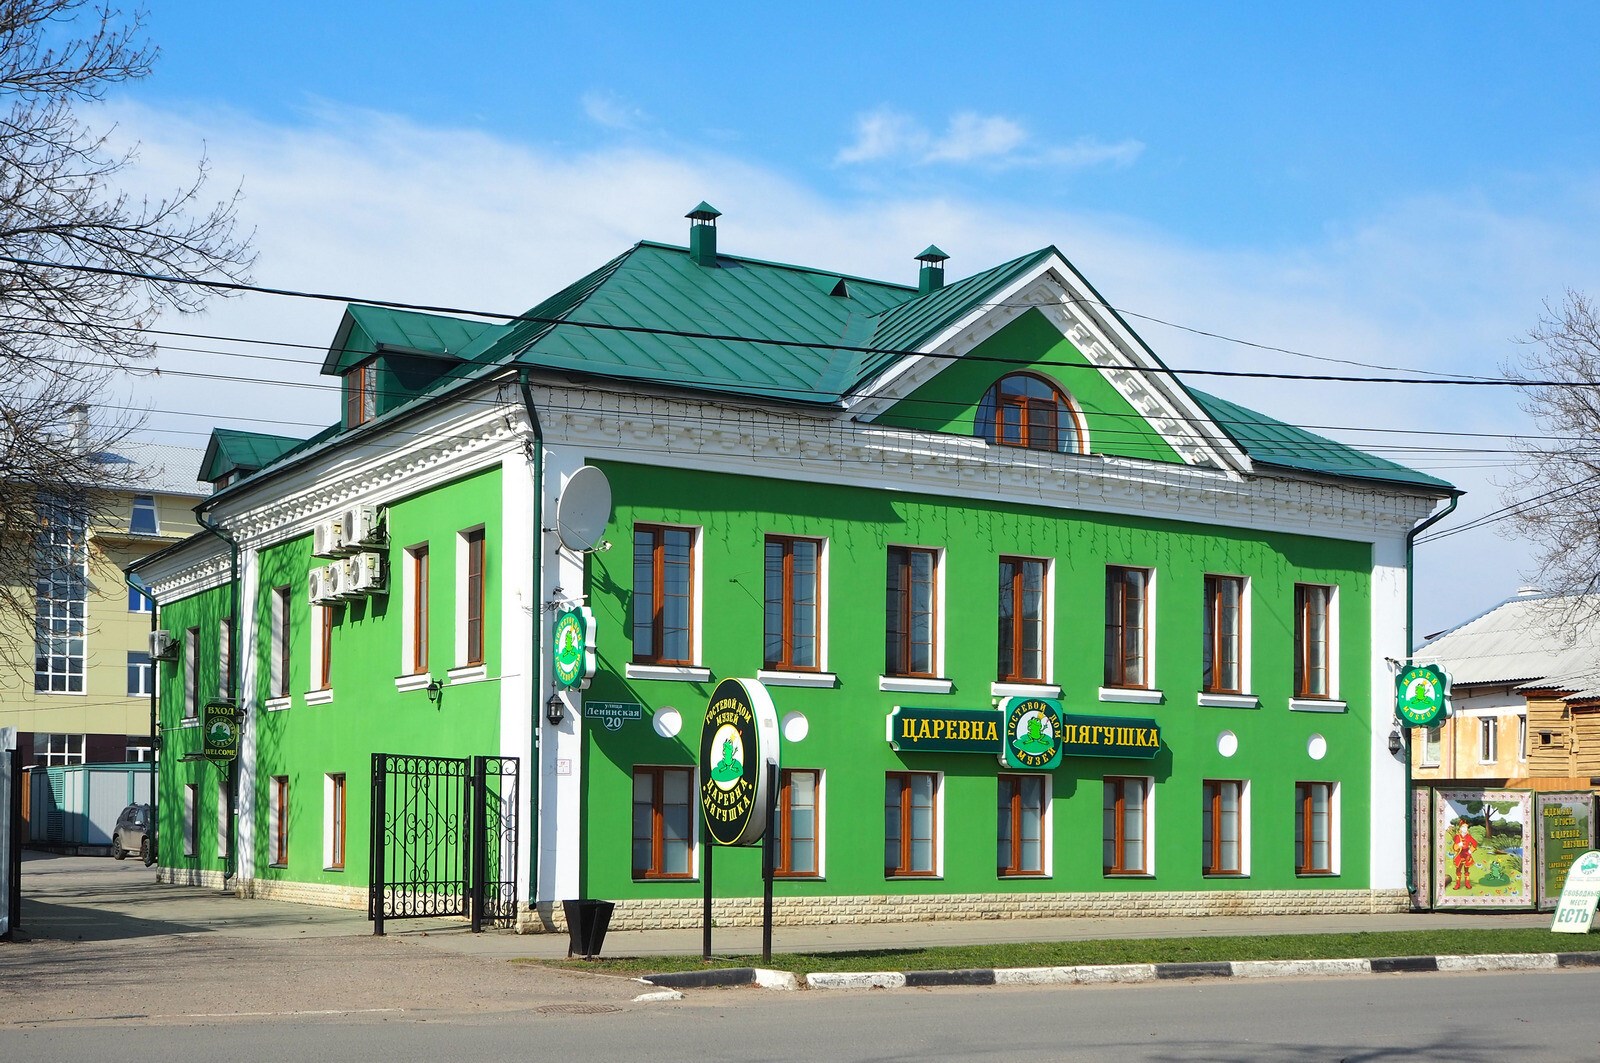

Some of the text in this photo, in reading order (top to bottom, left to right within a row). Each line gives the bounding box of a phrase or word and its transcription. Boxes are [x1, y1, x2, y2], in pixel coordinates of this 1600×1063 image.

[208, 706, 234, 716] ВХОД
[586, 707, 640, 716] Ленинская
[705, 698, 752, 726] ГОСТЕВОЙ ДОМ
[1403, 706, 1436, 720] MUSEUM
[606, 716, 622, 728] 20
[716, 712, 739, 726] МУЗЕЙ
[1049, 714, 1061, 738] ДОМ
[902, 718, 1160, 748] ЦАРЕВНА ЛЯГУШКА
[706, 778, 748, 806] ЦАРЕВНА
[704, 794, 750, 822] ЛЯГУШКА
[1558, 908, 1589, 923] ЕСТЬ
